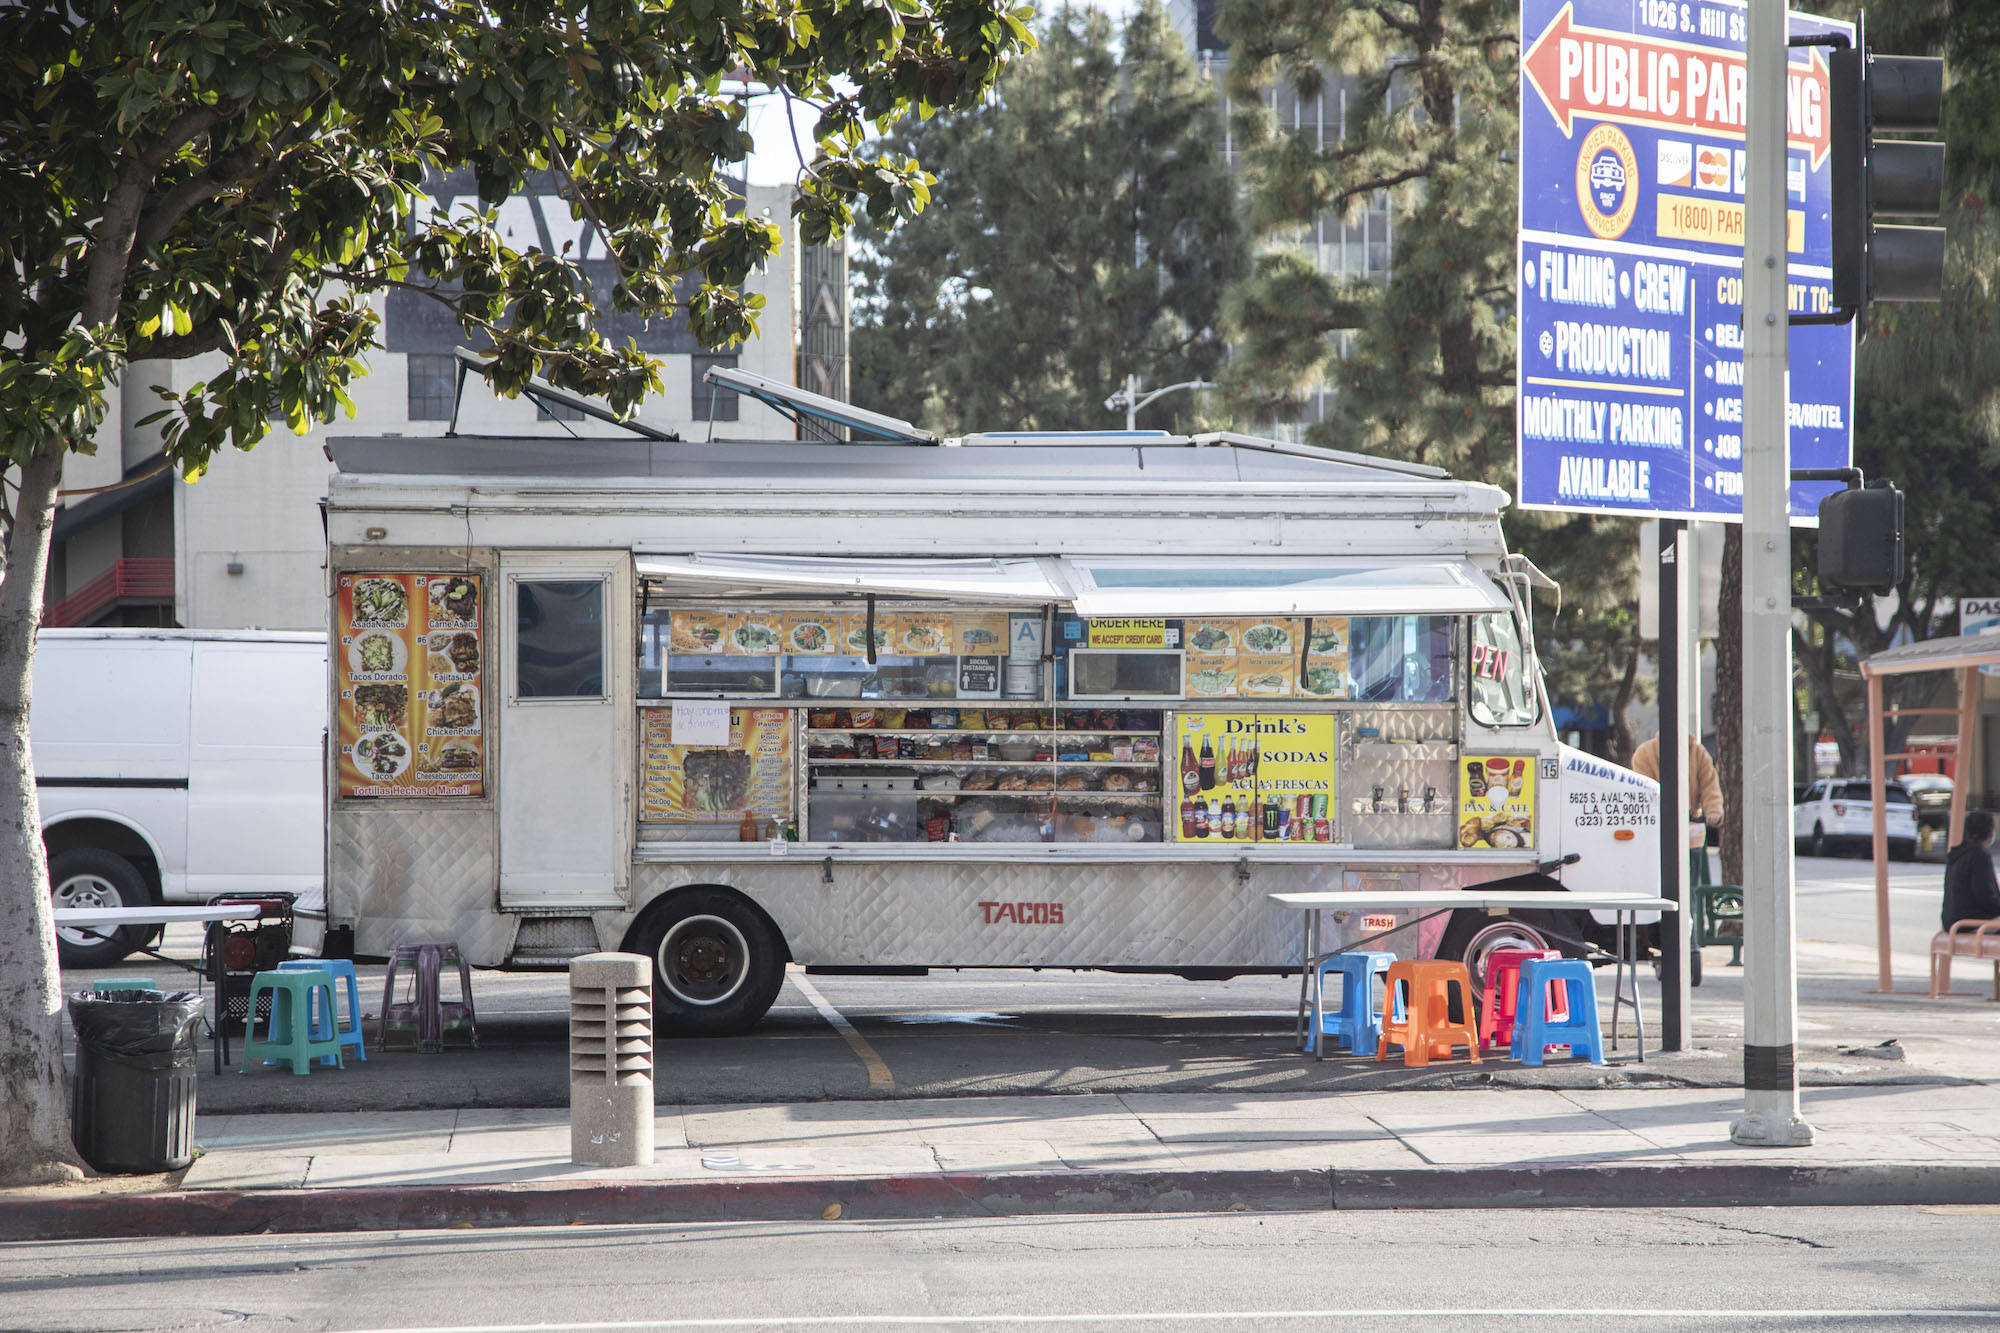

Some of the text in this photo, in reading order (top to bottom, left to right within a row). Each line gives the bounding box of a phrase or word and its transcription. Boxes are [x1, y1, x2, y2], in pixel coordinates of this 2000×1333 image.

[1640, 0, 1677, 30] 1026
[1680, 4, 1696, 33] S.
[1700, 8, 1726, 39] Hill
[1560, 38, 1822, 138] PUBLIC PARNG
[1672, 203, 1713, 236] 1(800)
[1540, 251, 1686, 315] FILMING CREW
[1556, 322, 1670, 381] PRODUCTION
[1715, 397, 1742, 423] ACE
[1524, 397, 1684, 450] MONTHLY PARKING
[1714, 434, 1741, 459] JOB
[1558, 456, 1650, 502] AVAILABLE
[416, 578, 426, 586] #5
[429, 620, 478, 628] Carne Asada
[1090, 619, 1164, 628] ORDER HERE
[1017, 621, 1035, 641] A
[417, 636, 427, 644] #6
[1092, 635, 1162, 644] WE ACCEPT CREDIT CARD
[1471, 643, 1509, 682] PEN
[349, 673, 408, 681] Tacos Dorados
[418, 691, 427, 699] #7
[361, 724, 397, 732] Plater LA
[1226, 718, 1306, 734] Drink's
[649, 731, 666, 739] Tortas
[419, 744, 428, 752] #8
[1263, 751, 1328, 763] SODAS
[1543, 765, 1557, 777] 15
[1567, 758, 1616, 780] AVALON
[371, 772, 394, 780] Tacos
[416, 772, 481, 781] Cheeseburger combo
[1275, 779, 1328, 790] FRESCAS
[353, 786, 390, 795] Tortillas
[393, 786, 427, 795] Hechas
[660, 798, 671, 806] Dog
[1569, 792, 1588, 804] 5625
[1601, 792, 1636, 804] AVALON
[1464, 802, 1485, 812] PAN
[1605, 804, 1620, 815] CA
[1623, 804, 1650, 815] 90011
[1575, 815, 1656, 827] (323) 231-5116
[978, 901, 1064, 925] TACOS
[1363, 918, 1394, 928] TRASH
